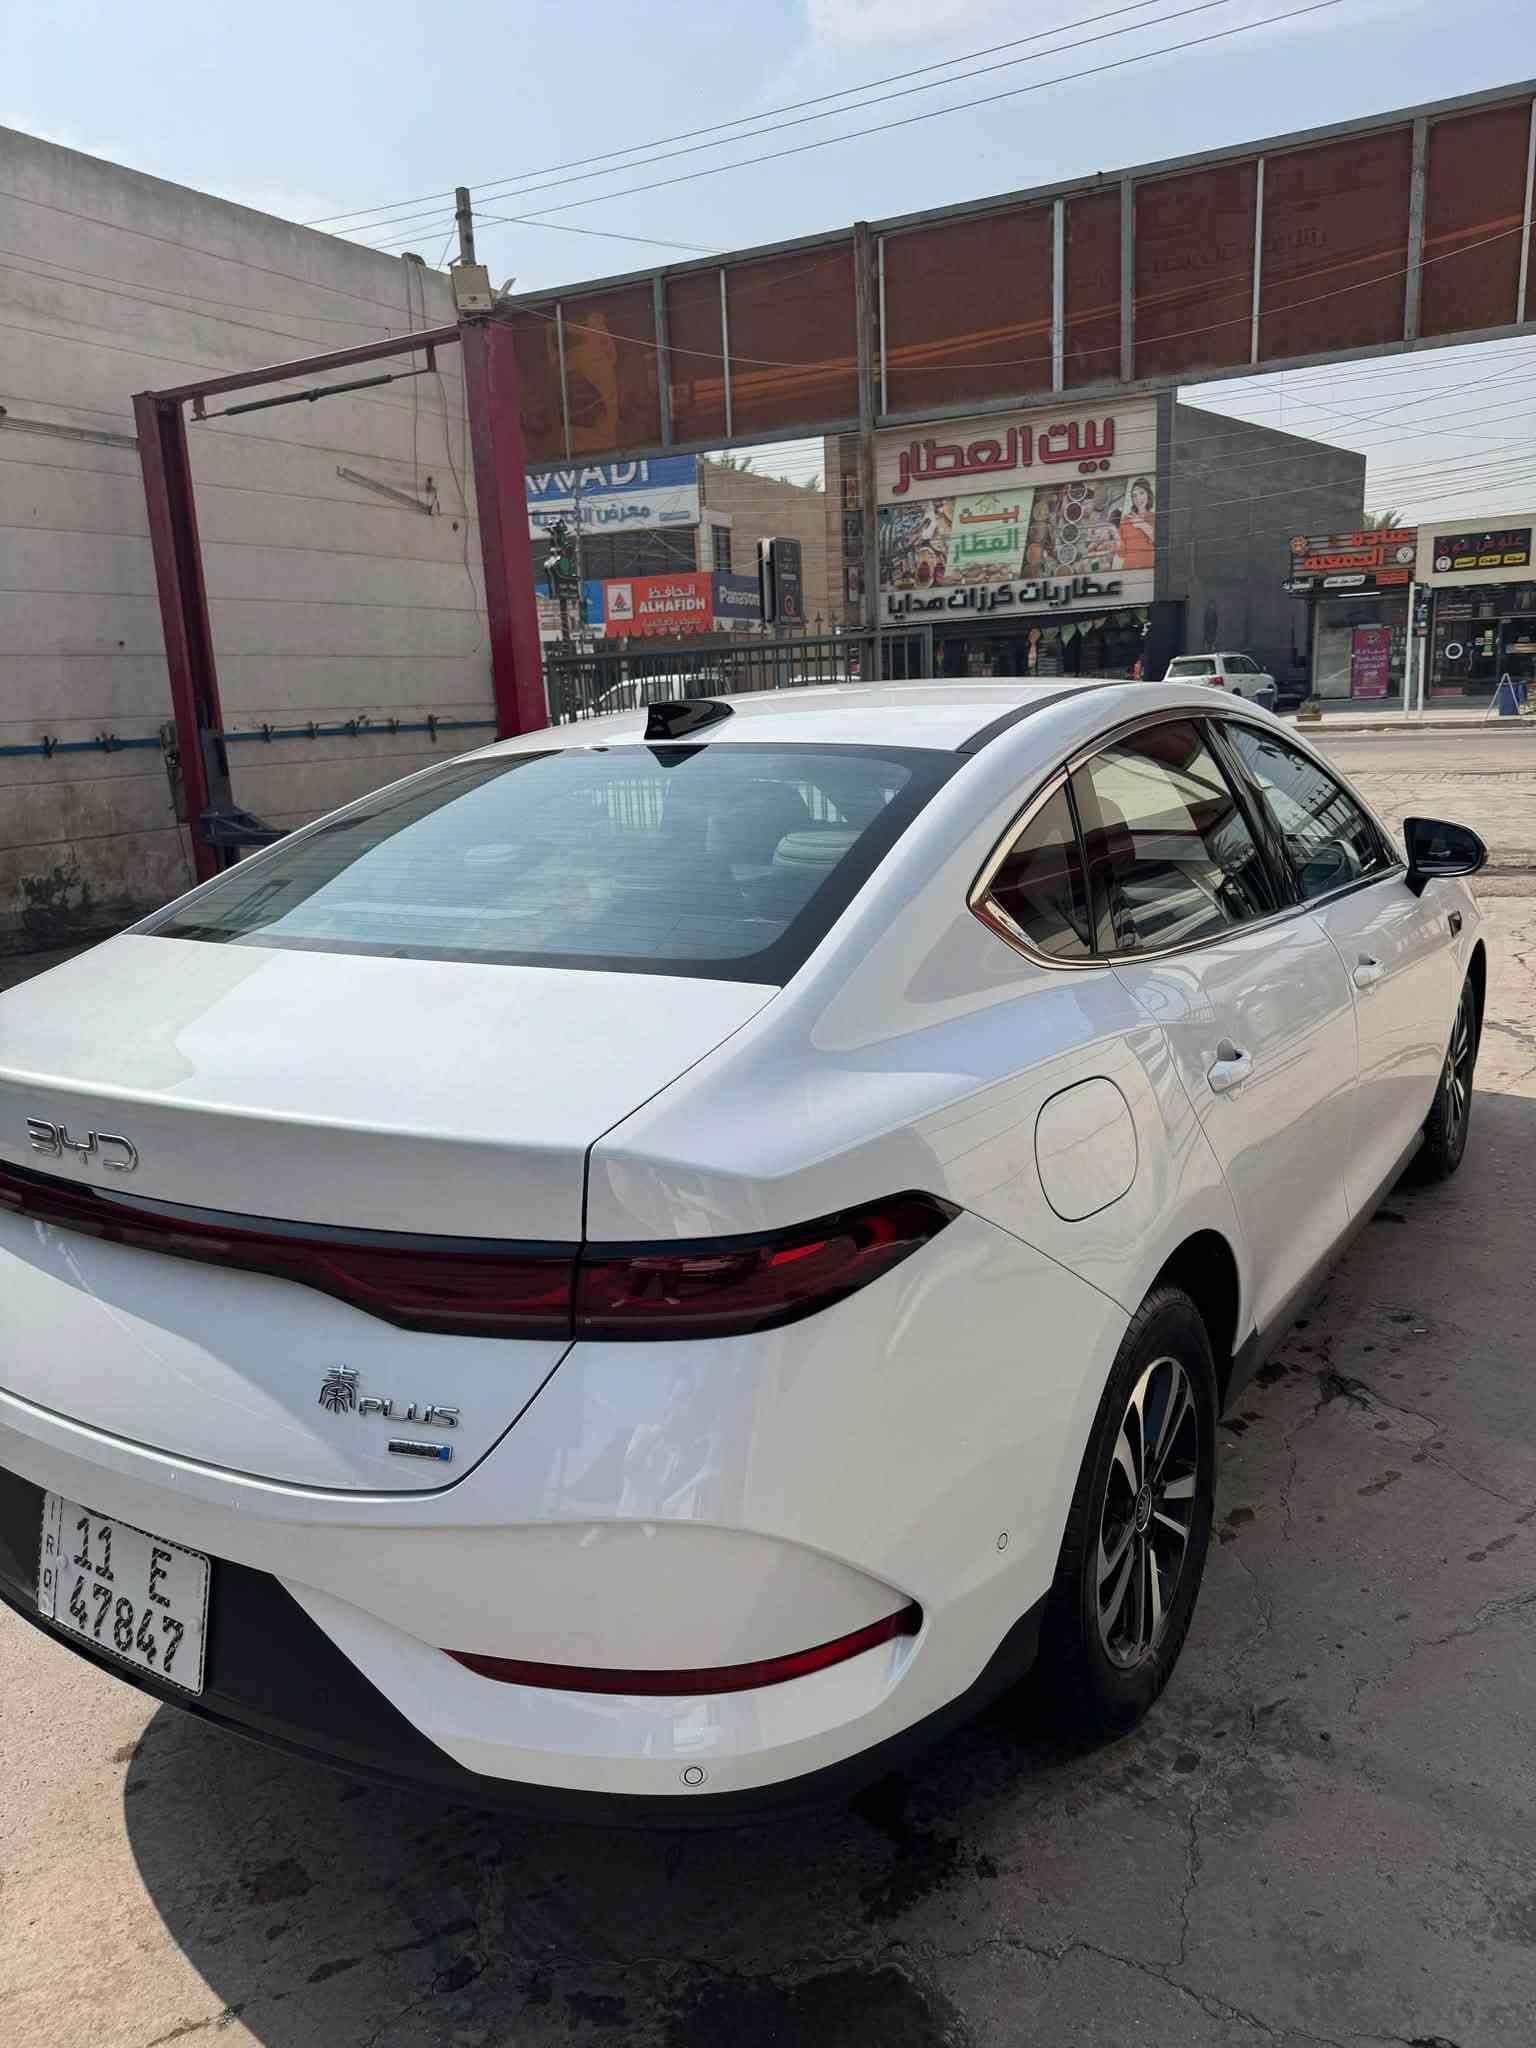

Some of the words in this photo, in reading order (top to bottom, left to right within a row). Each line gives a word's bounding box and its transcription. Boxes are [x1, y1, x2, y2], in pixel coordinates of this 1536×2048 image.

[893, 425, 1033, 494] العطار
[1039, 417, 1115, 474] بيت
[959, 504, 1020, 526] بيت
[953, 527, 1019, 563] العطار
[639, 597, 706, 614] ALHAFIDH
[888, 593, 947, 620] هدايا
[948, 584, 1012, 612] كرزات
[1019, 577, 1122, 607] عطاريات
[26, 1116, 138, 1172] BYD
[359, 1396, 460, 1428] PLUS
[73, 1517, 114, 1582] 11
[149, 1547, 173, 1608] E
[70, 1575, 185, 1673] 47847
